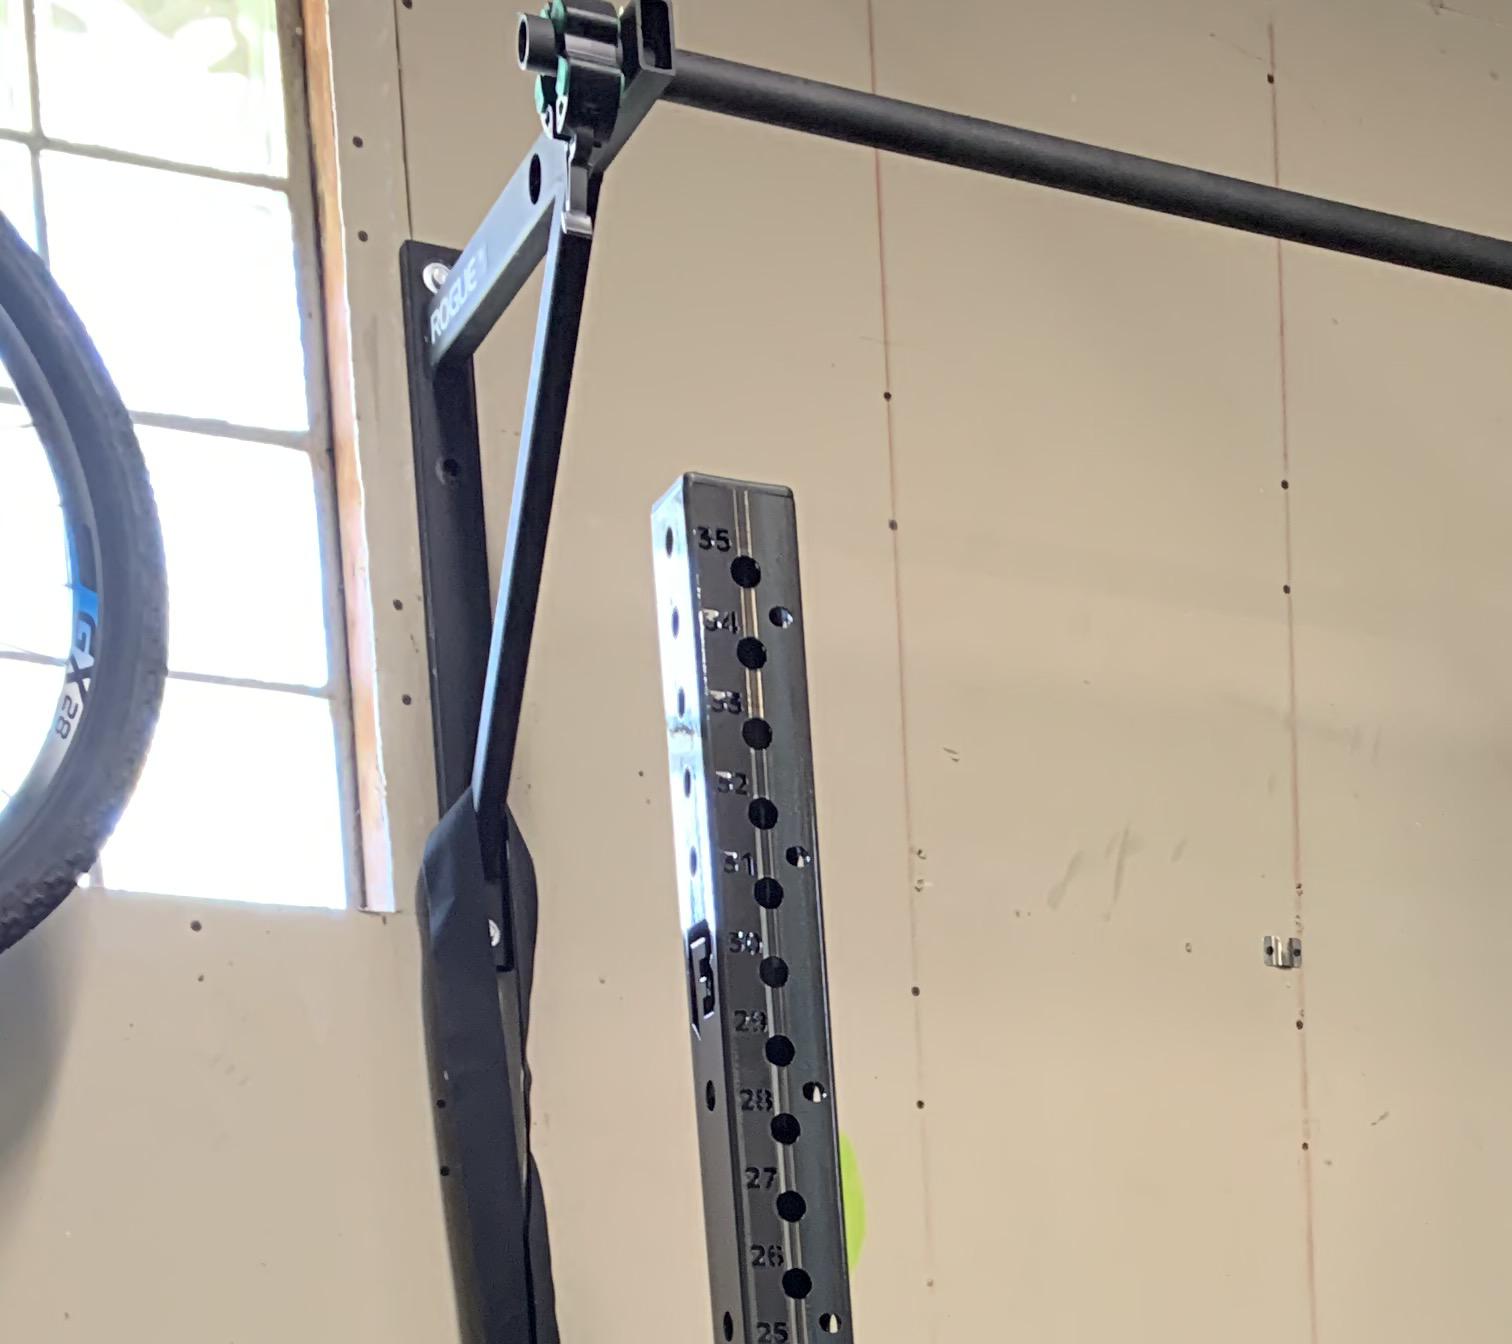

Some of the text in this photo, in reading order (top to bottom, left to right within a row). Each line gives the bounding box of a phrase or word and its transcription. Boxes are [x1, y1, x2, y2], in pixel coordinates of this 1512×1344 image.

[430, 256, 477, 345] ROGUE
[697, 525, 732, 553] 35
[740, 1088, 774, 1112] 28
[745, 1166, 778, 1189] 27
[751, 1244, 785, 1268] 26
[756, 1321, 789, 1344] 25
